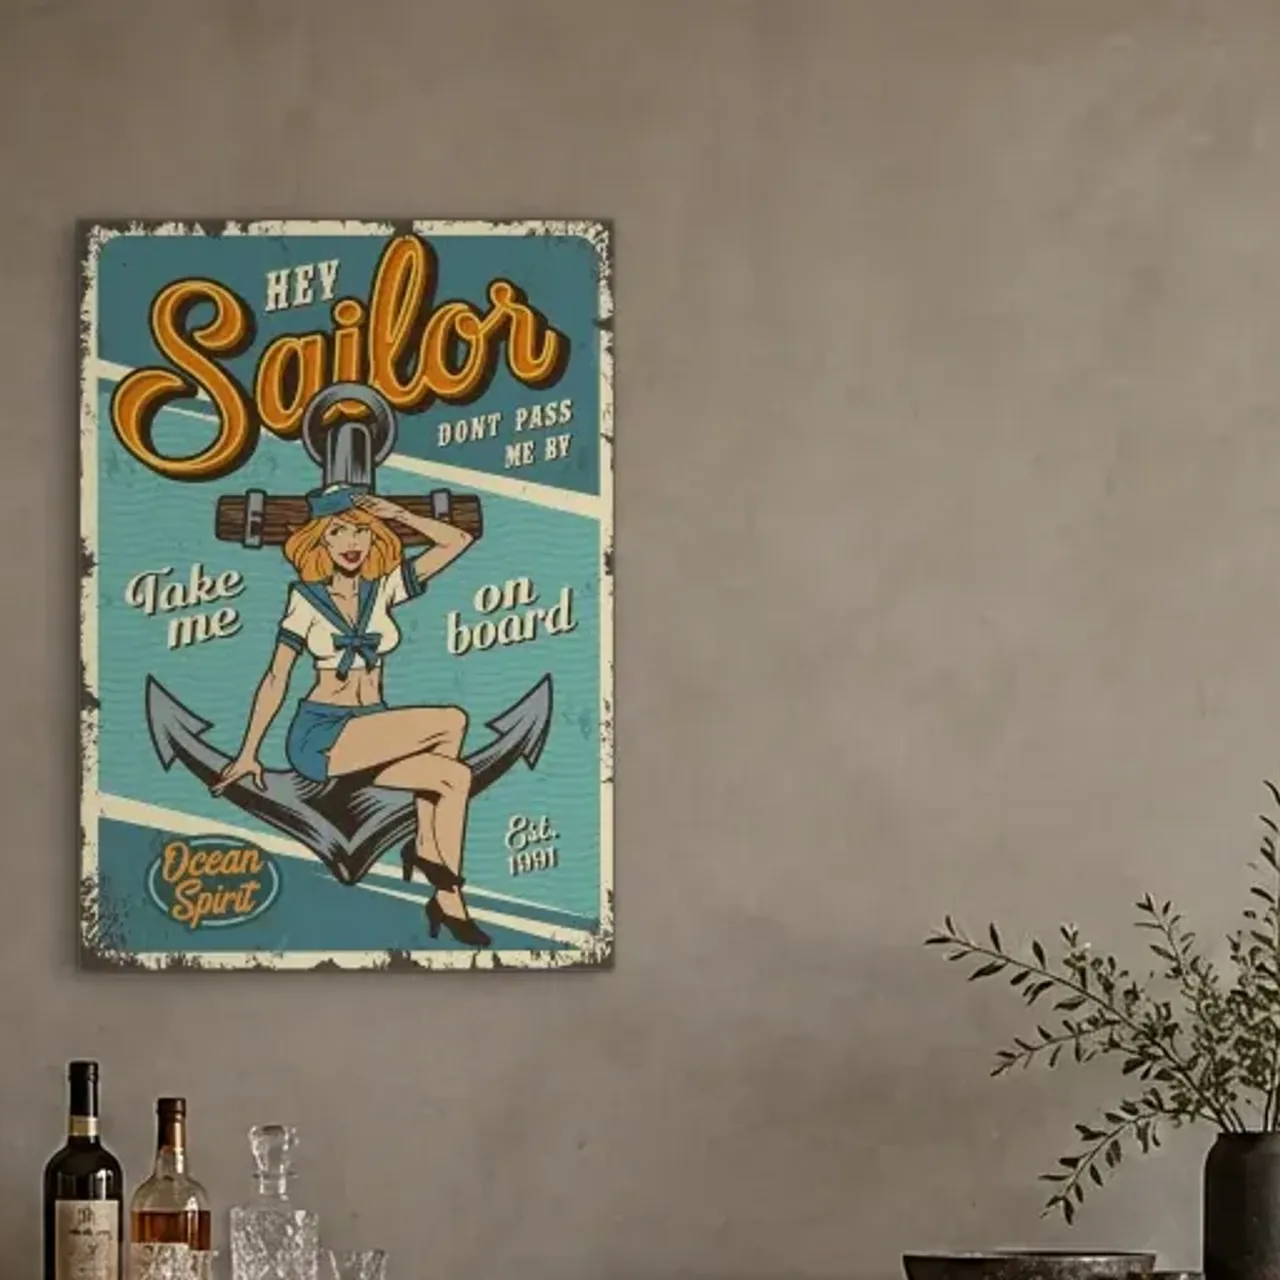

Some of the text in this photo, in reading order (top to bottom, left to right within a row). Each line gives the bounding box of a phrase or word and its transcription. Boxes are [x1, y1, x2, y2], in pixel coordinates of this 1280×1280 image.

[265, 259, 340, 312] HEY
[111, 234, 571, 481] Sailor
[437, 399, 573, 447] DONT PASS
[504, 434, 572, 468] ME BY
[125, 563, 247, 616] Take
[474, 575, 538, 615] on
[167, 606, 244, 650] me
[446, 587, 577, 656] board
[505, 814, 560, 852] Est.
[162, 841, 263, 883] Ocean
[508, 846, 558, 876] 1991
[172, 879, 260, 929] Spirit
